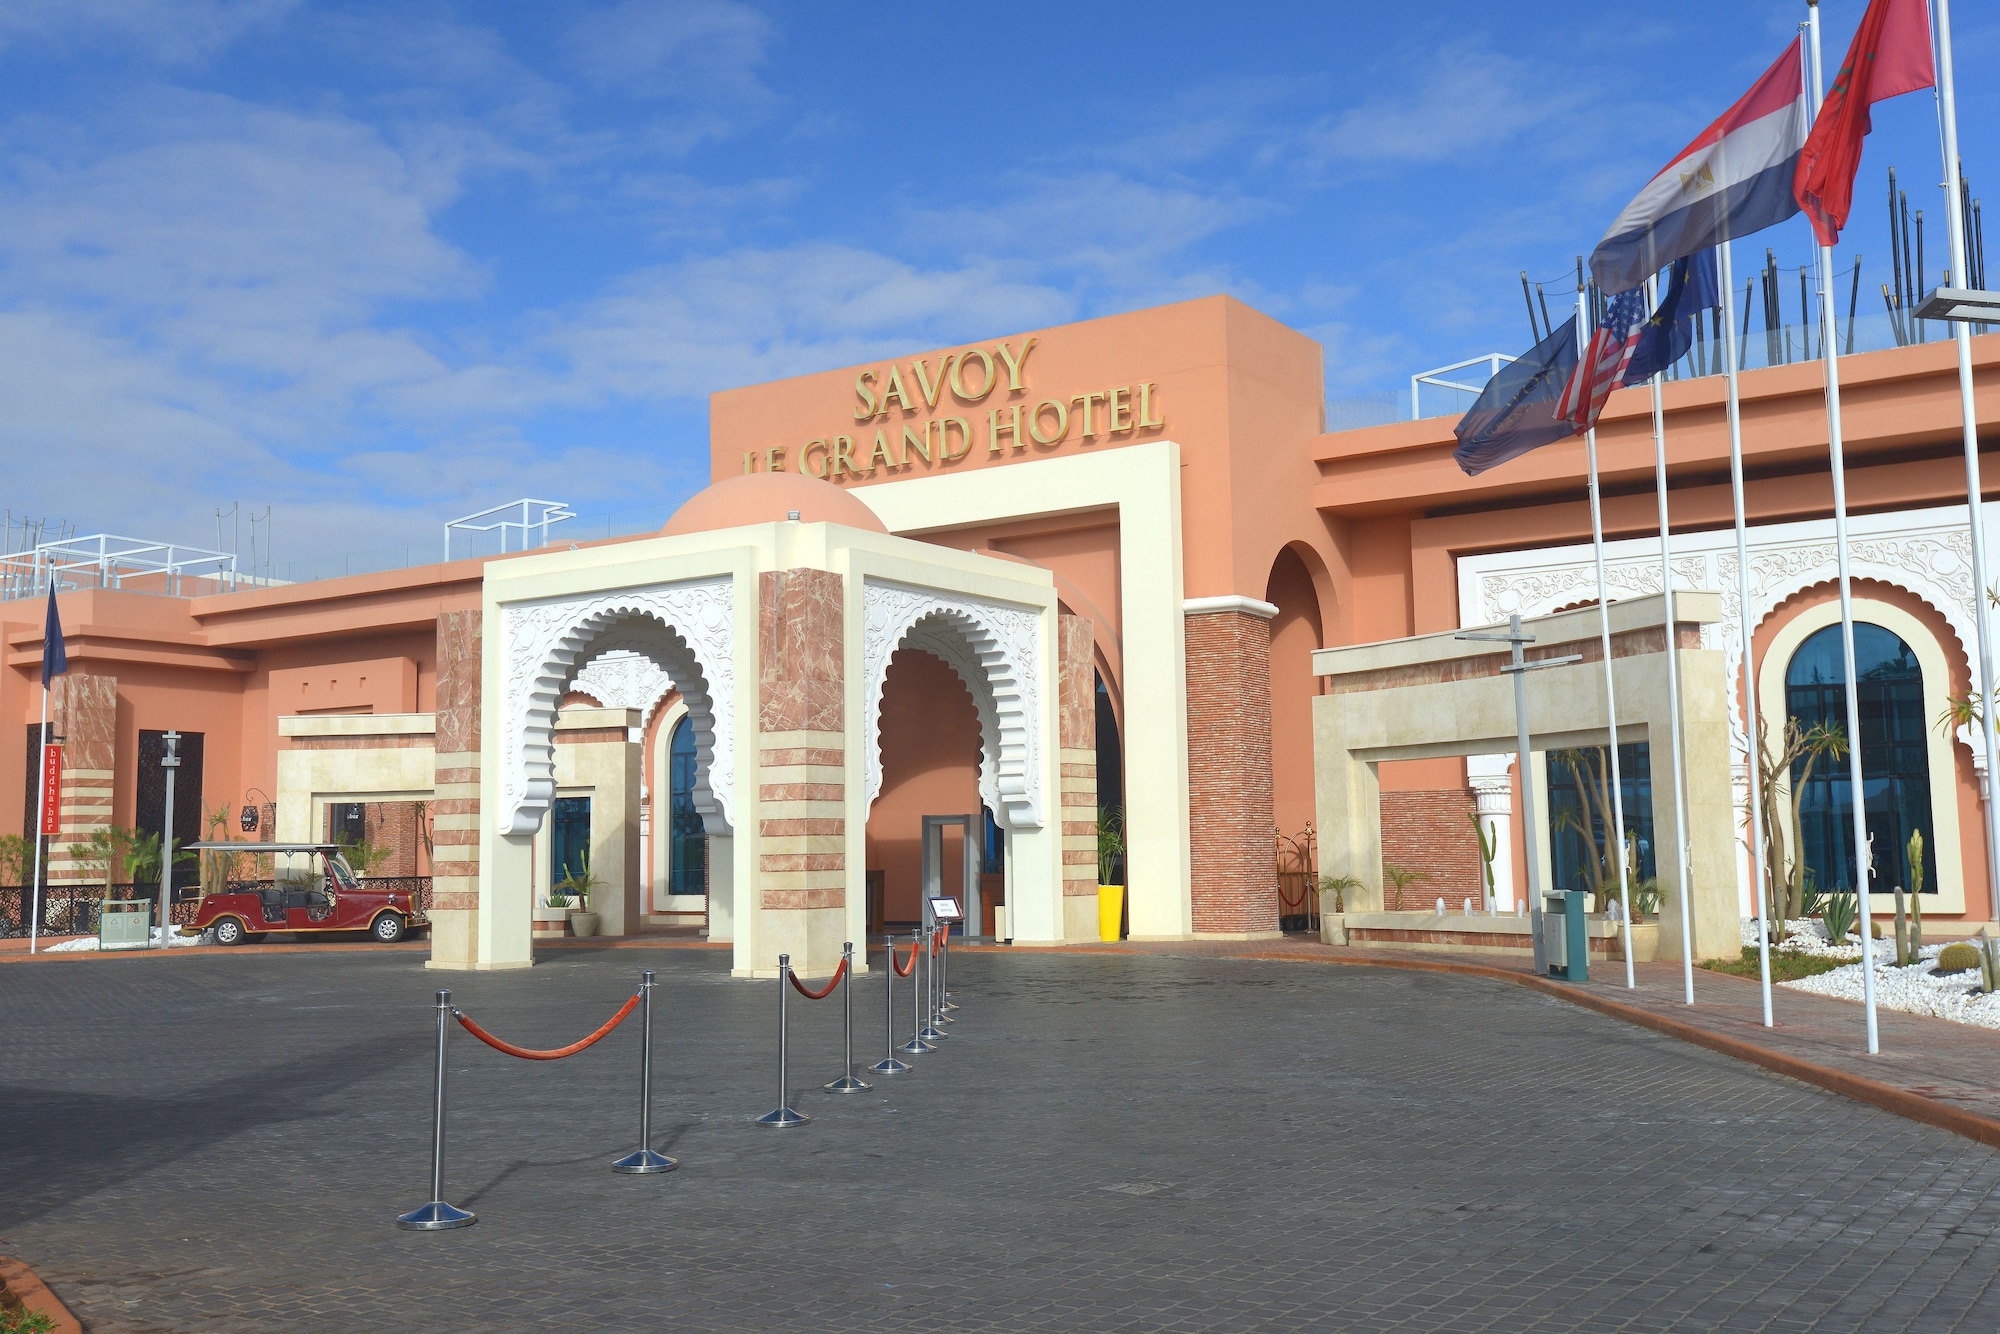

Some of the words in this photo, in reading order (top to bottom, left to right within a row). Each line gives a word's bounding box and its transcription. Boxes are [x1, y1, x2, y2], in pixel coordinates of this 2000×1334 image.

[854, 338, 1036, 420] SAVOY
[799, 416, 972, 479] GRAND
[987, 383, 1165, 452] HOTEL
[47, 748, 57, 831] buddha-bar
